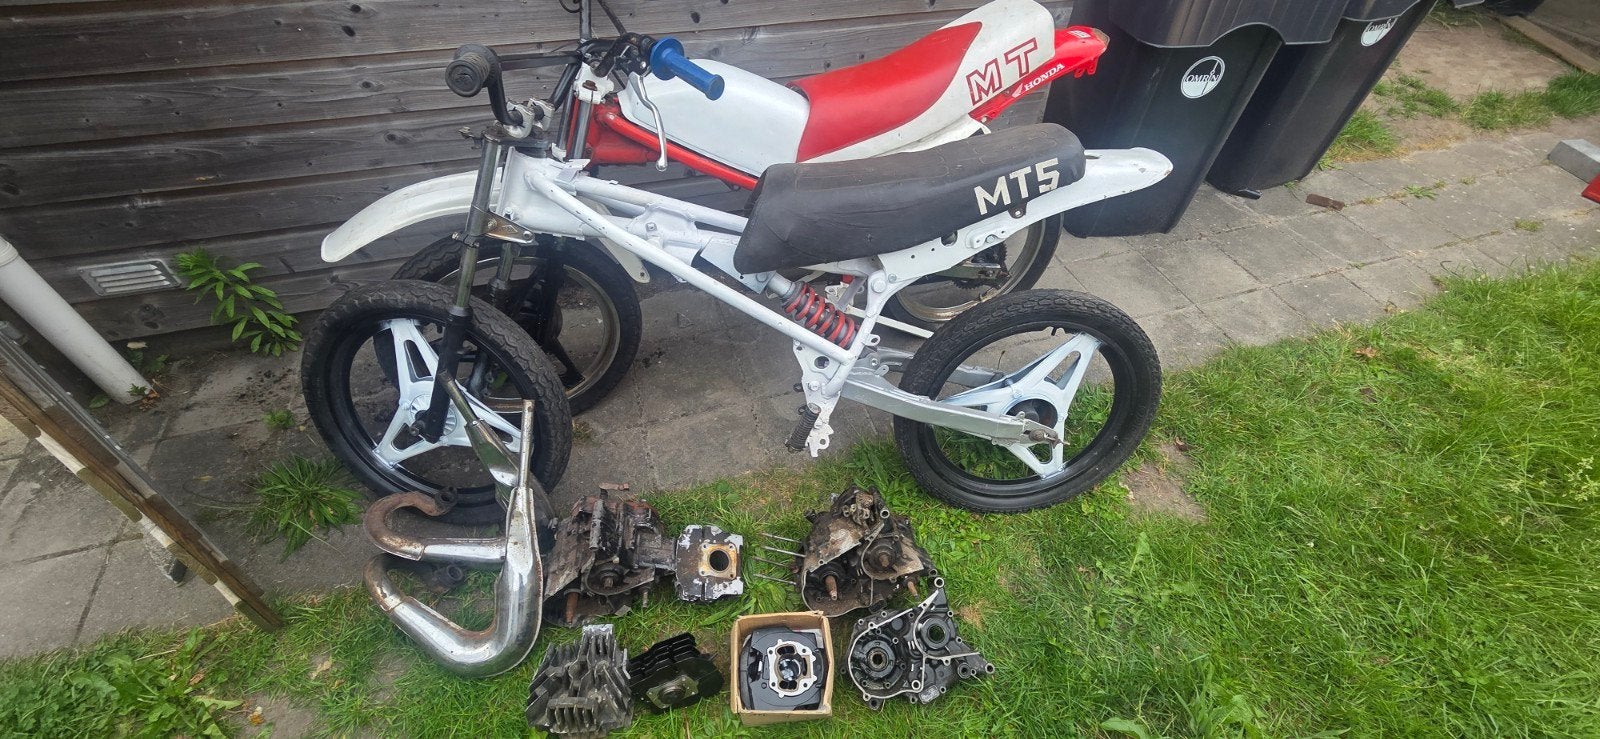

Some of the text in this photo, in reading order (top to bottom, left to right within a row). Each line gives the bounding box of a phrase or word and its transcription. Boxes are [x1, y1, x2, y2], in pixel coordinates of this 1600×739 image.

[966, 38, 1038, 106] MT
[1024, 64, 1065, 92] HONDA
[1185, 73, 1220, 83] OMRIN
[974, 157, 1059, 216] MT5
